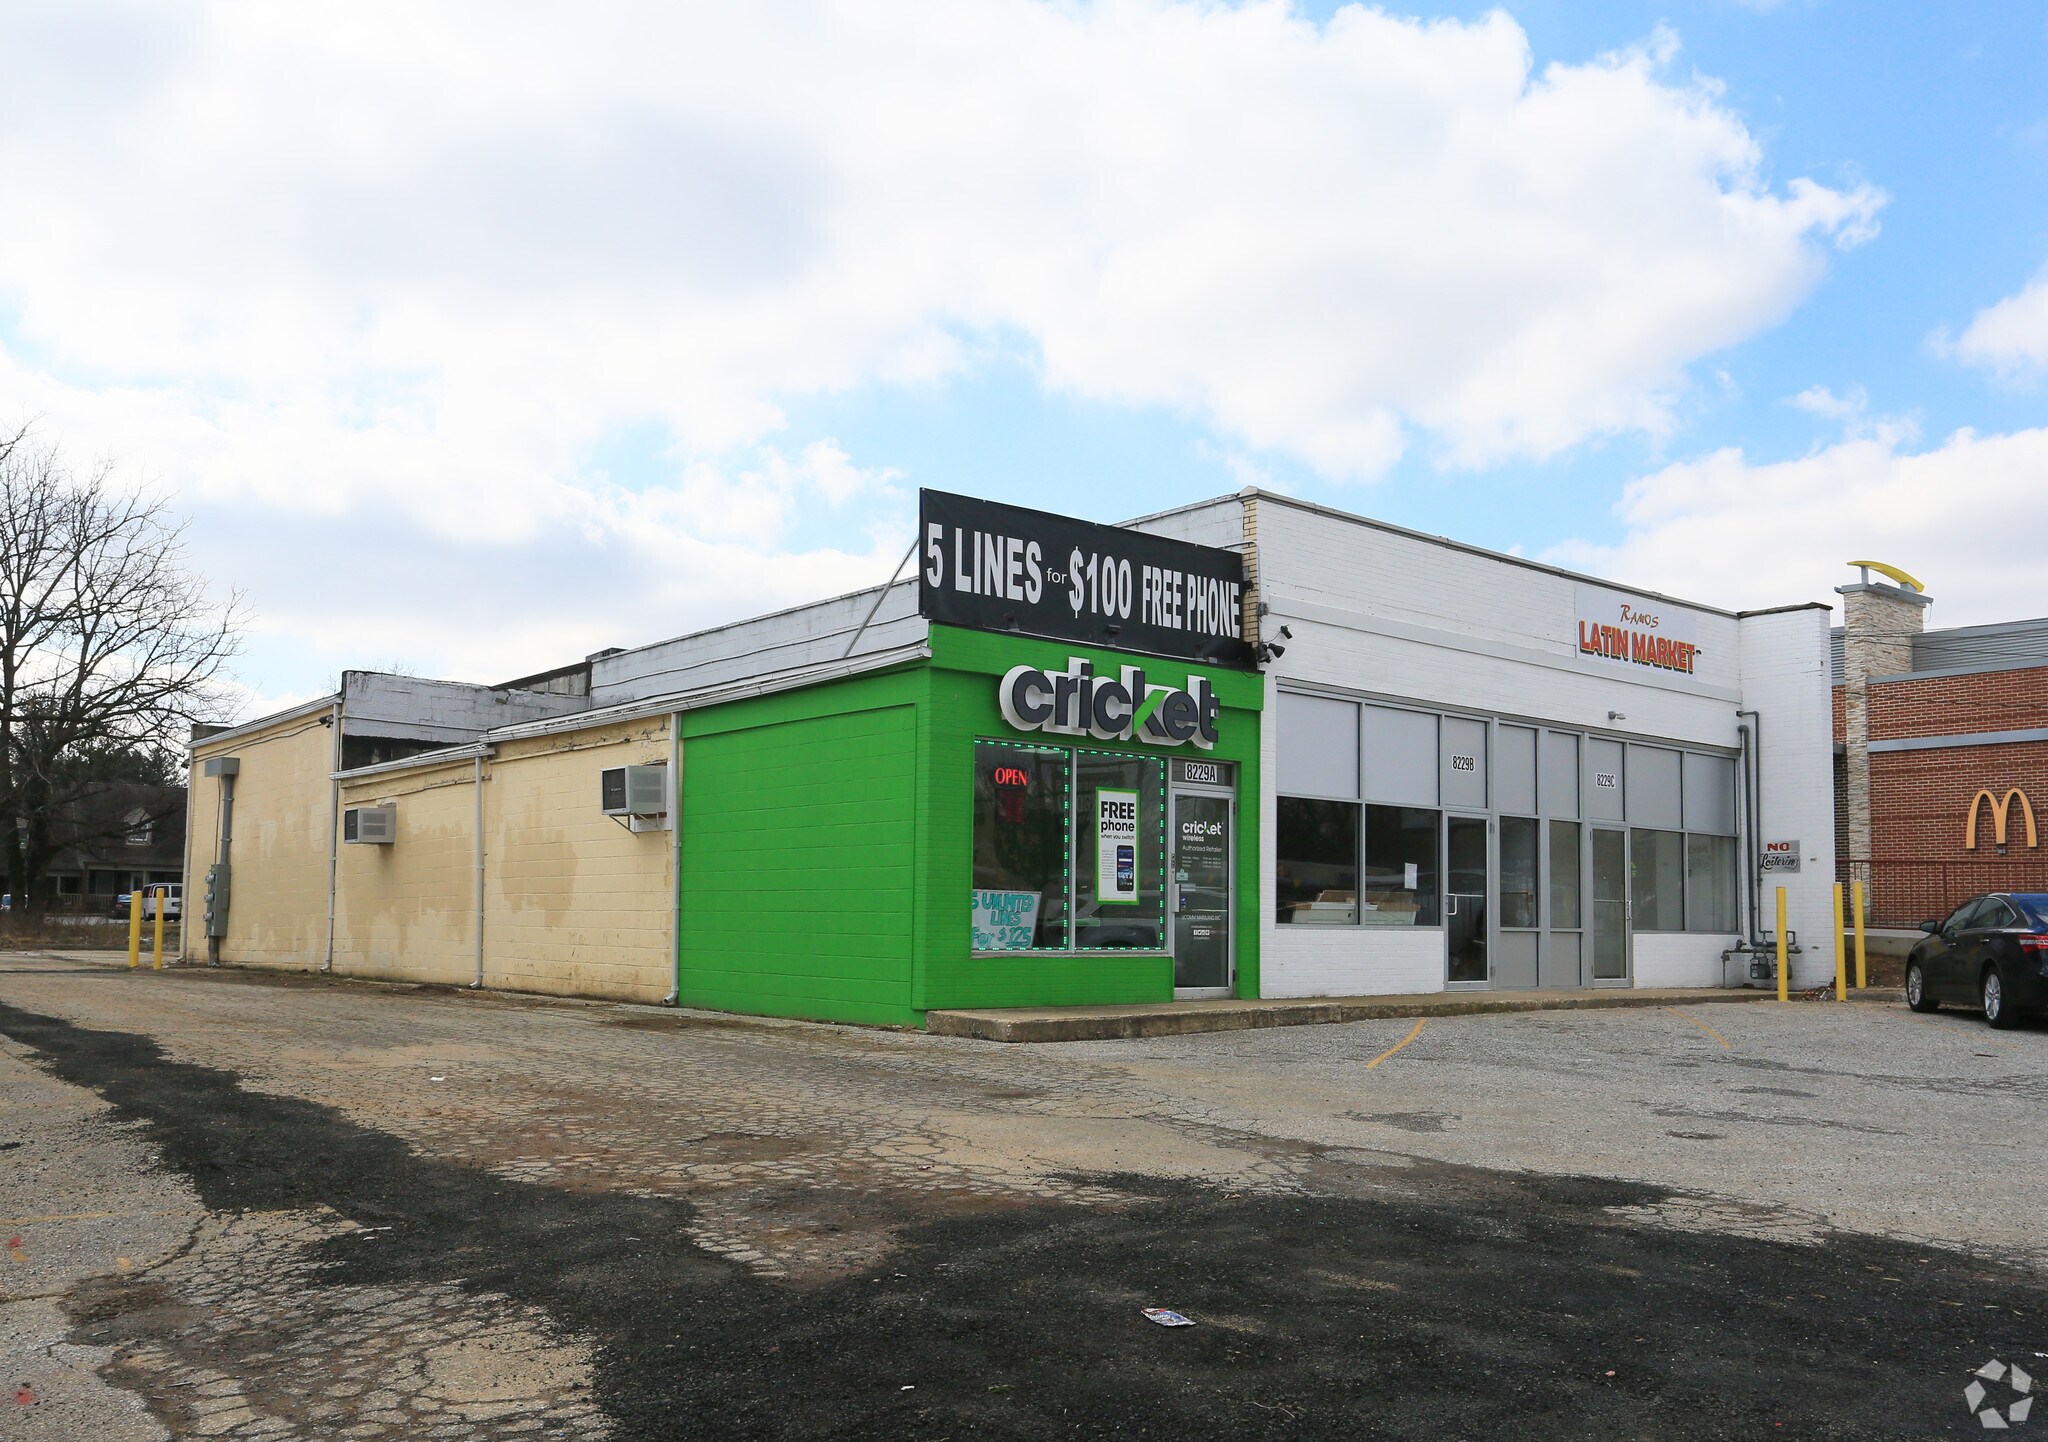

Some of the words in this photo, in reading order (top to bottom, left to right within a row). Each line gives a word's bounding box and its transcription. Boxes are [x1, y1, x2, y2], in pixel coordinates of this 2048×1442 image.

[926, 522, 943, 588] 5
[955, 527, 1042, 604] LINES
[1046, 567, 1067, 584] for
[1069, 545, 1132, 618] $100
[1142, 565, 1182, 630] FREE
[1187, 574, 1240, 638] PHONE
[1579, 620, 1629, 661] LATIN
[1632, 632, 1695, 674] MARKET
[1000, 656, 1221, 749] cricket
[1453, 756, 1474, 771] 8229B
[995, 767, 1027, 786] OPEN
[1187, 764, 1216, 781] 8229A
[1596, 773, 1614, 787] 8229C
[1101, 801, 1135, 820] FREE
[1101, 819, 1135, 833] phone
[1182, 820, 1222, 836] cricket
[1182, 834, 1205, 842] wireless
[1182, 844, 1205, 852] Authorized
[1206, 845, 1222, 853] Retailer
[1767, 843, 1791, 852] NO
[1760, 853, 1799, 870] Loitering
[990, 910, 1022, 927] LINES
